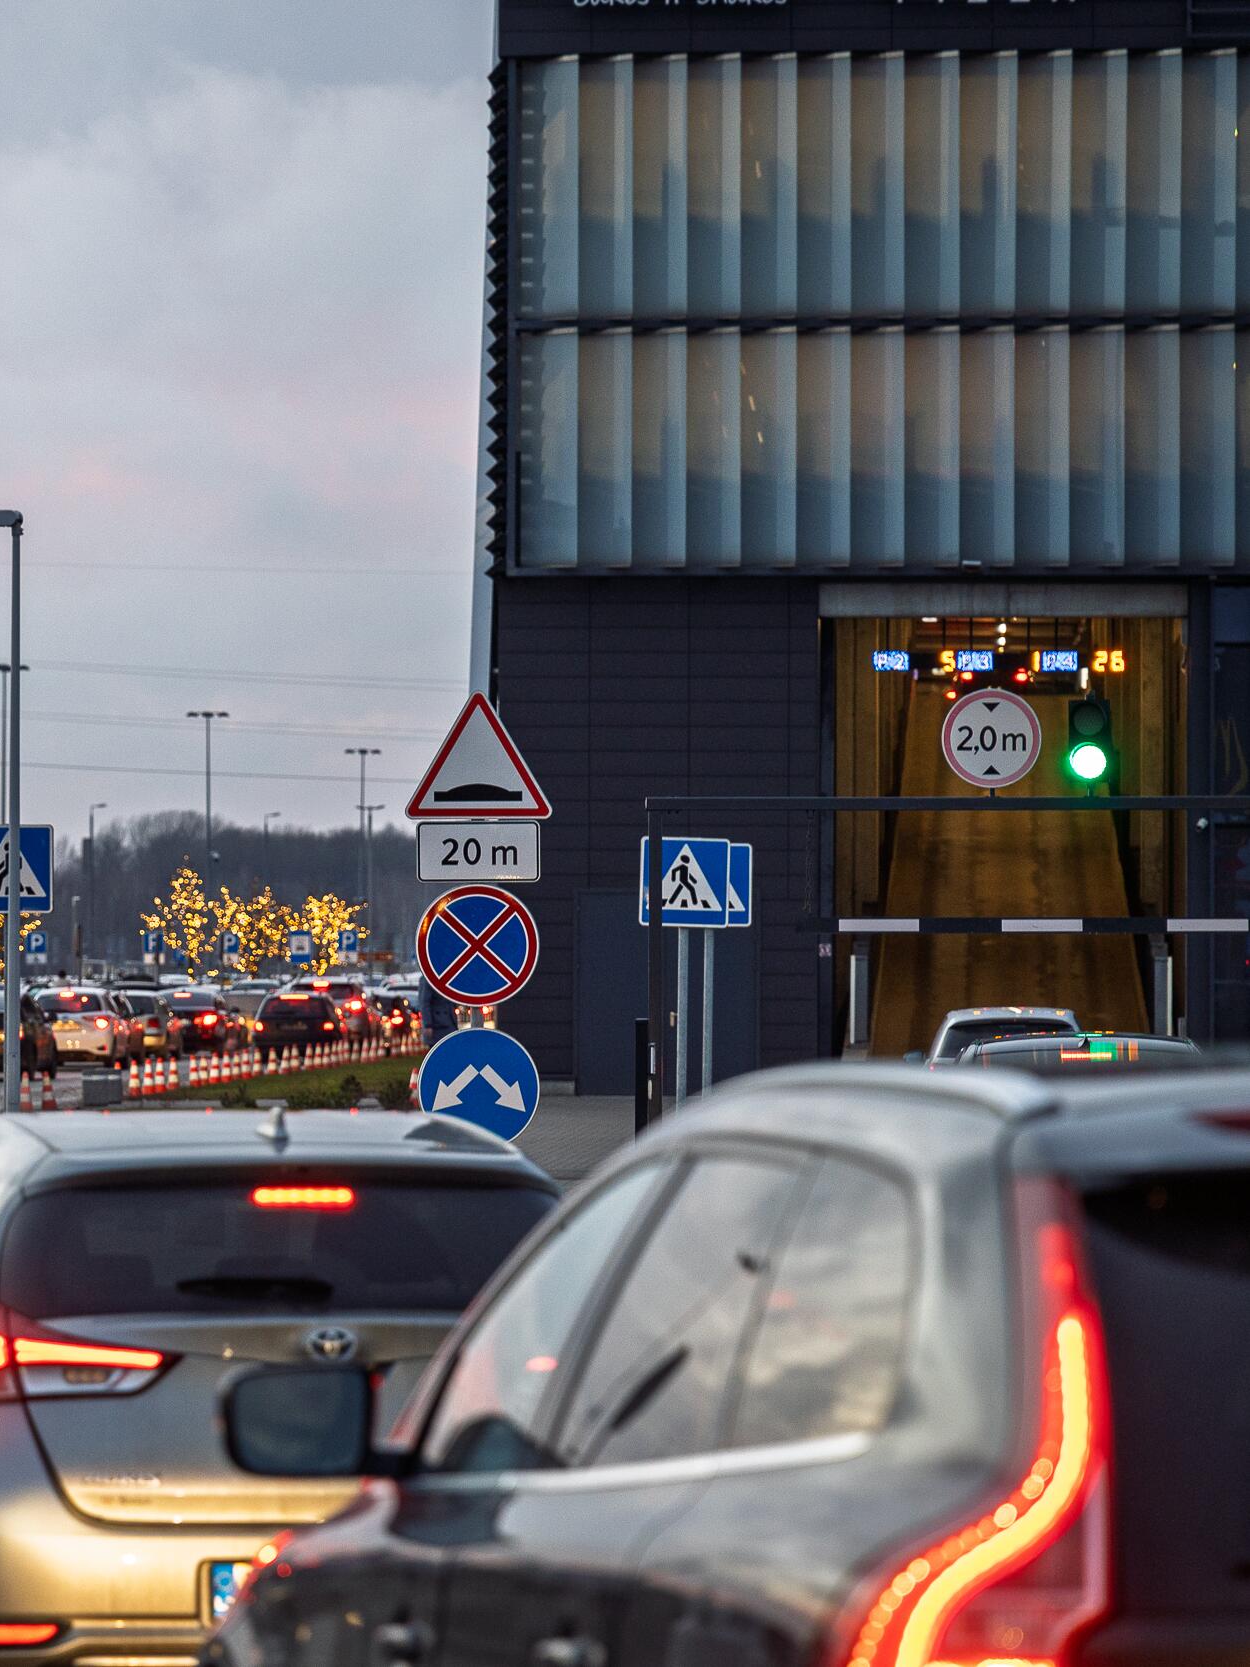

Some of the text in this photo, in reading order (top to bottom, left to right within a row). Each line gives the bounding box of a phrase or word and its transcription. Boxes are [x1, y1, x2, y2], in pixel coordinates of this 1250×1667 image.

[941, 650, 956, 672] 5
[1092, 650, 1125, 672] 26
[956, 725, 1027, 755] 2,0 m
[441, 837, 518, 866] 20 m
